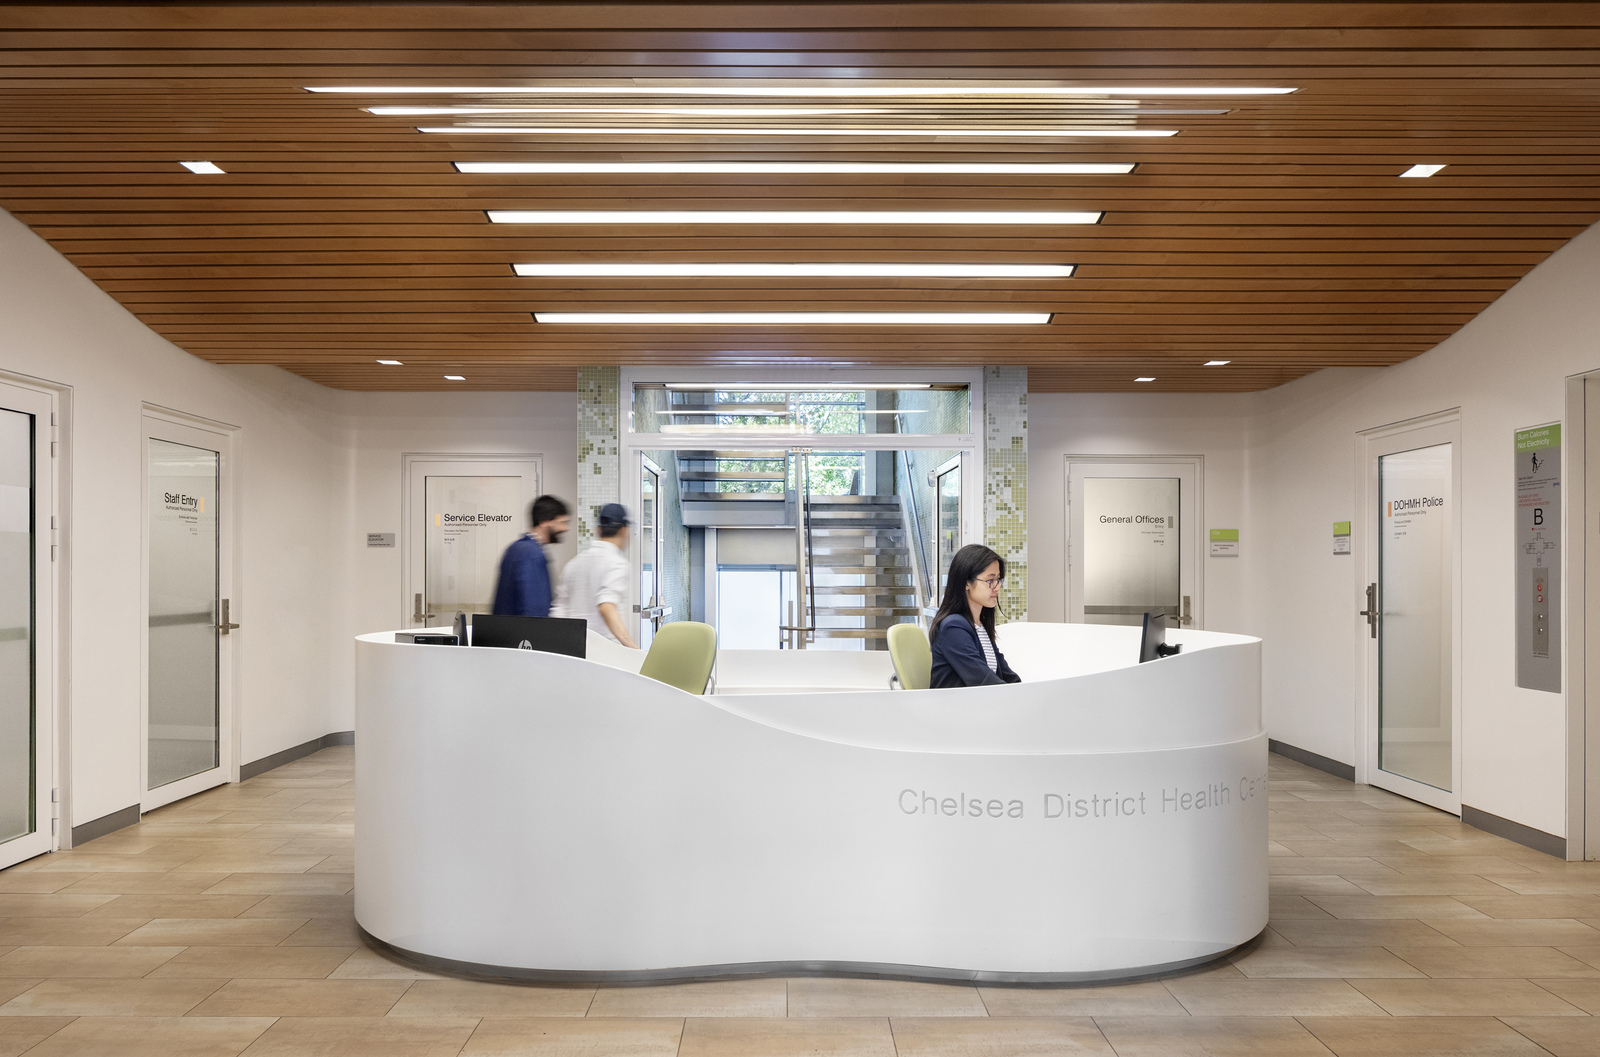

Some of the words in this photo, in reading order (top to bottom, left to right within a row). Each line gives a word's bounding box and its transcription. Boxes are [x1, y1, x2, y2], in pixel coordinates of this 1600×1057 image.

[1517, 433, 1529, 441] Burn
[1530, 429, 1550, 438] Calories
[1517, 441, 1528, 449] Not
[1527, 438, 1551, 448] Electricity
[164, 492, 180, 504] Staff
[181, 494, 198, 509] Entry
[1393, 498, 1421, 511] DOHMH
[1422, 496, 1444, 508] Police
[444, 513, 476, 522] Service
[477, 513, 513, 522] Elevator
[1099, 514, 1133, 524] General
[1135, 514, 1165, 524] Offices
[1534, 508, 1544, 526] B
[898, 788, 1024, 819] Chelsea
[1043, 791, 1146, 819] District
[1162, 782, 1231, 813] Health
